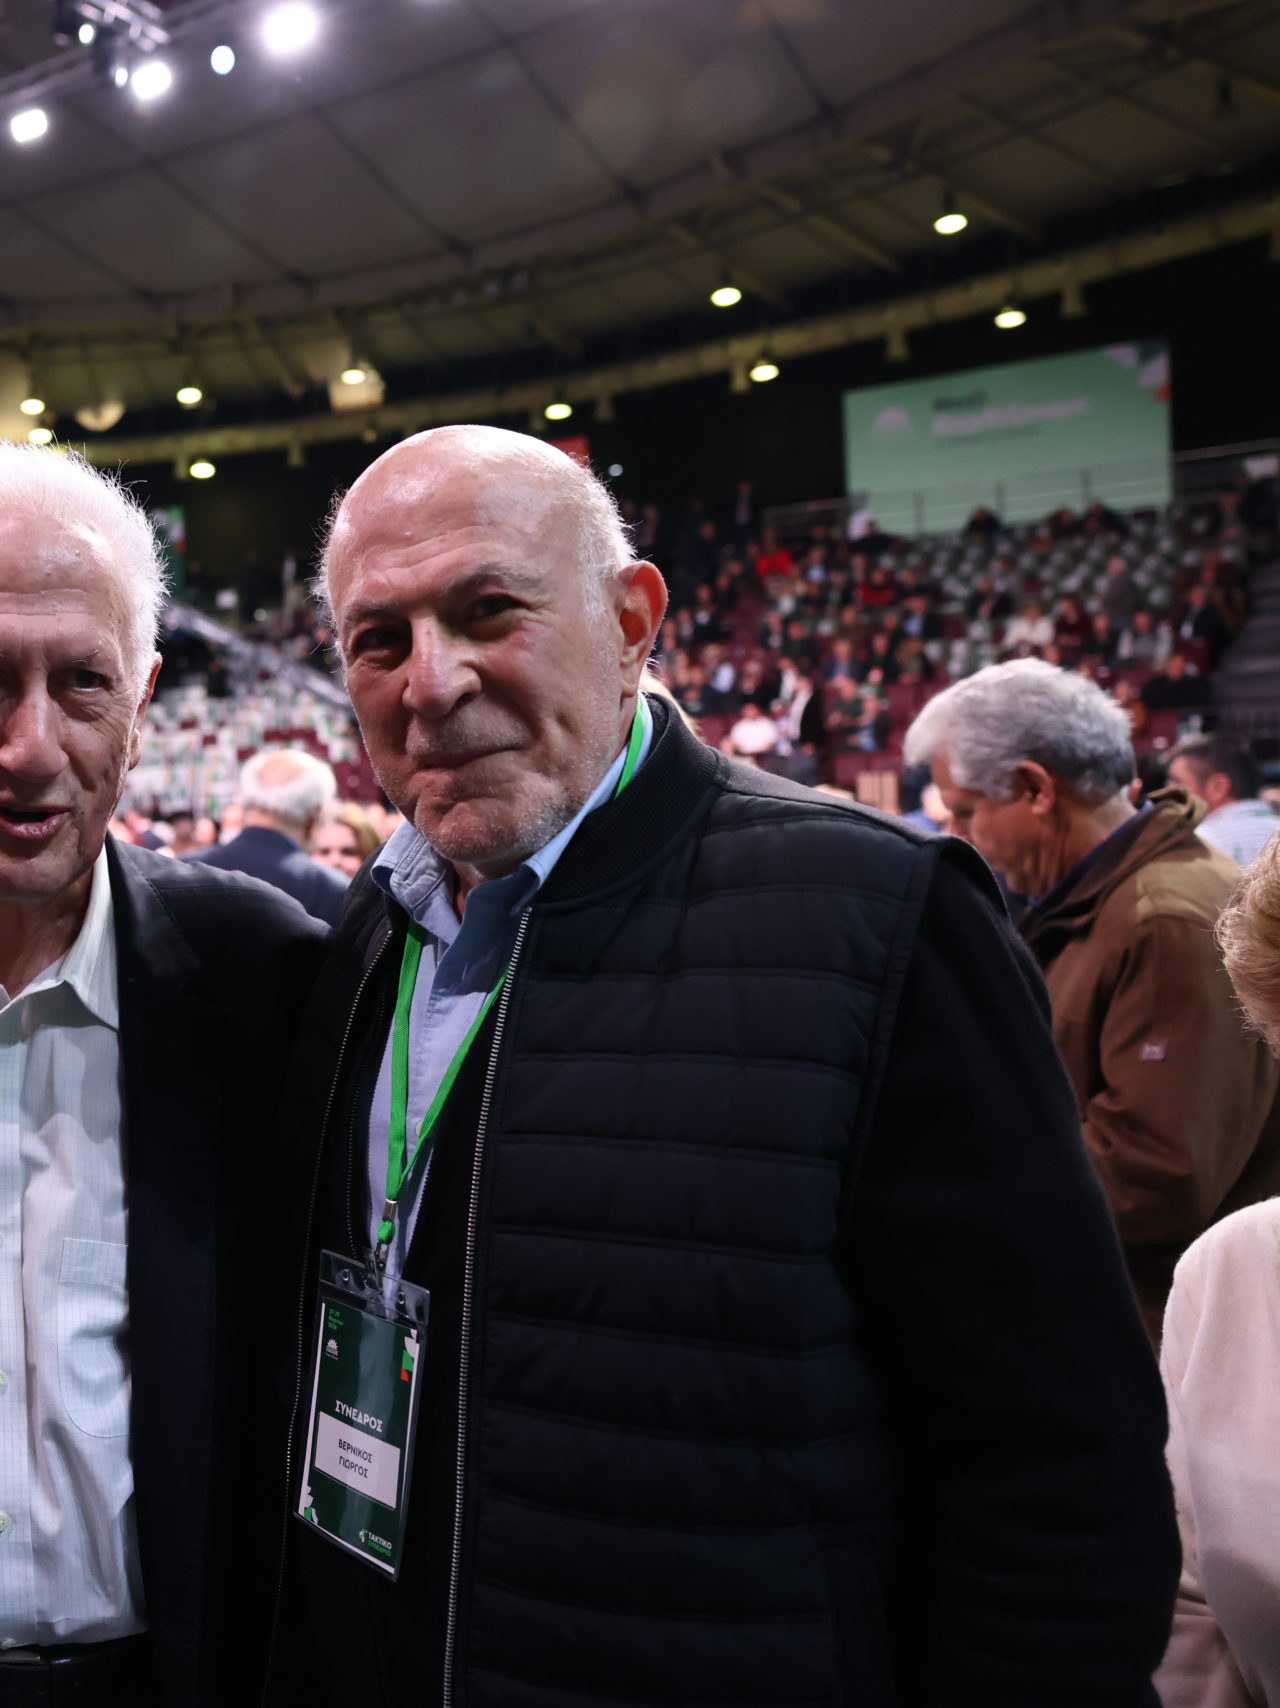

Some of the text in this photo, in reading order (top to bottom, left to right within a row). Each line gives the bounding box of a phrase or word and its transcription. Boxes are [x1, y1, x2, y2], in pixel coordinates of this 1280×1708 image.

[335, 1400, 383, 1432] ΣΥΝΕΔΡΟΣ
[338, 1439, 373, 1464] ΒΕΡΝΙΚΟΣ
[338, 1456, 368, 1478] ΓΙΩΡΓΟΣ
